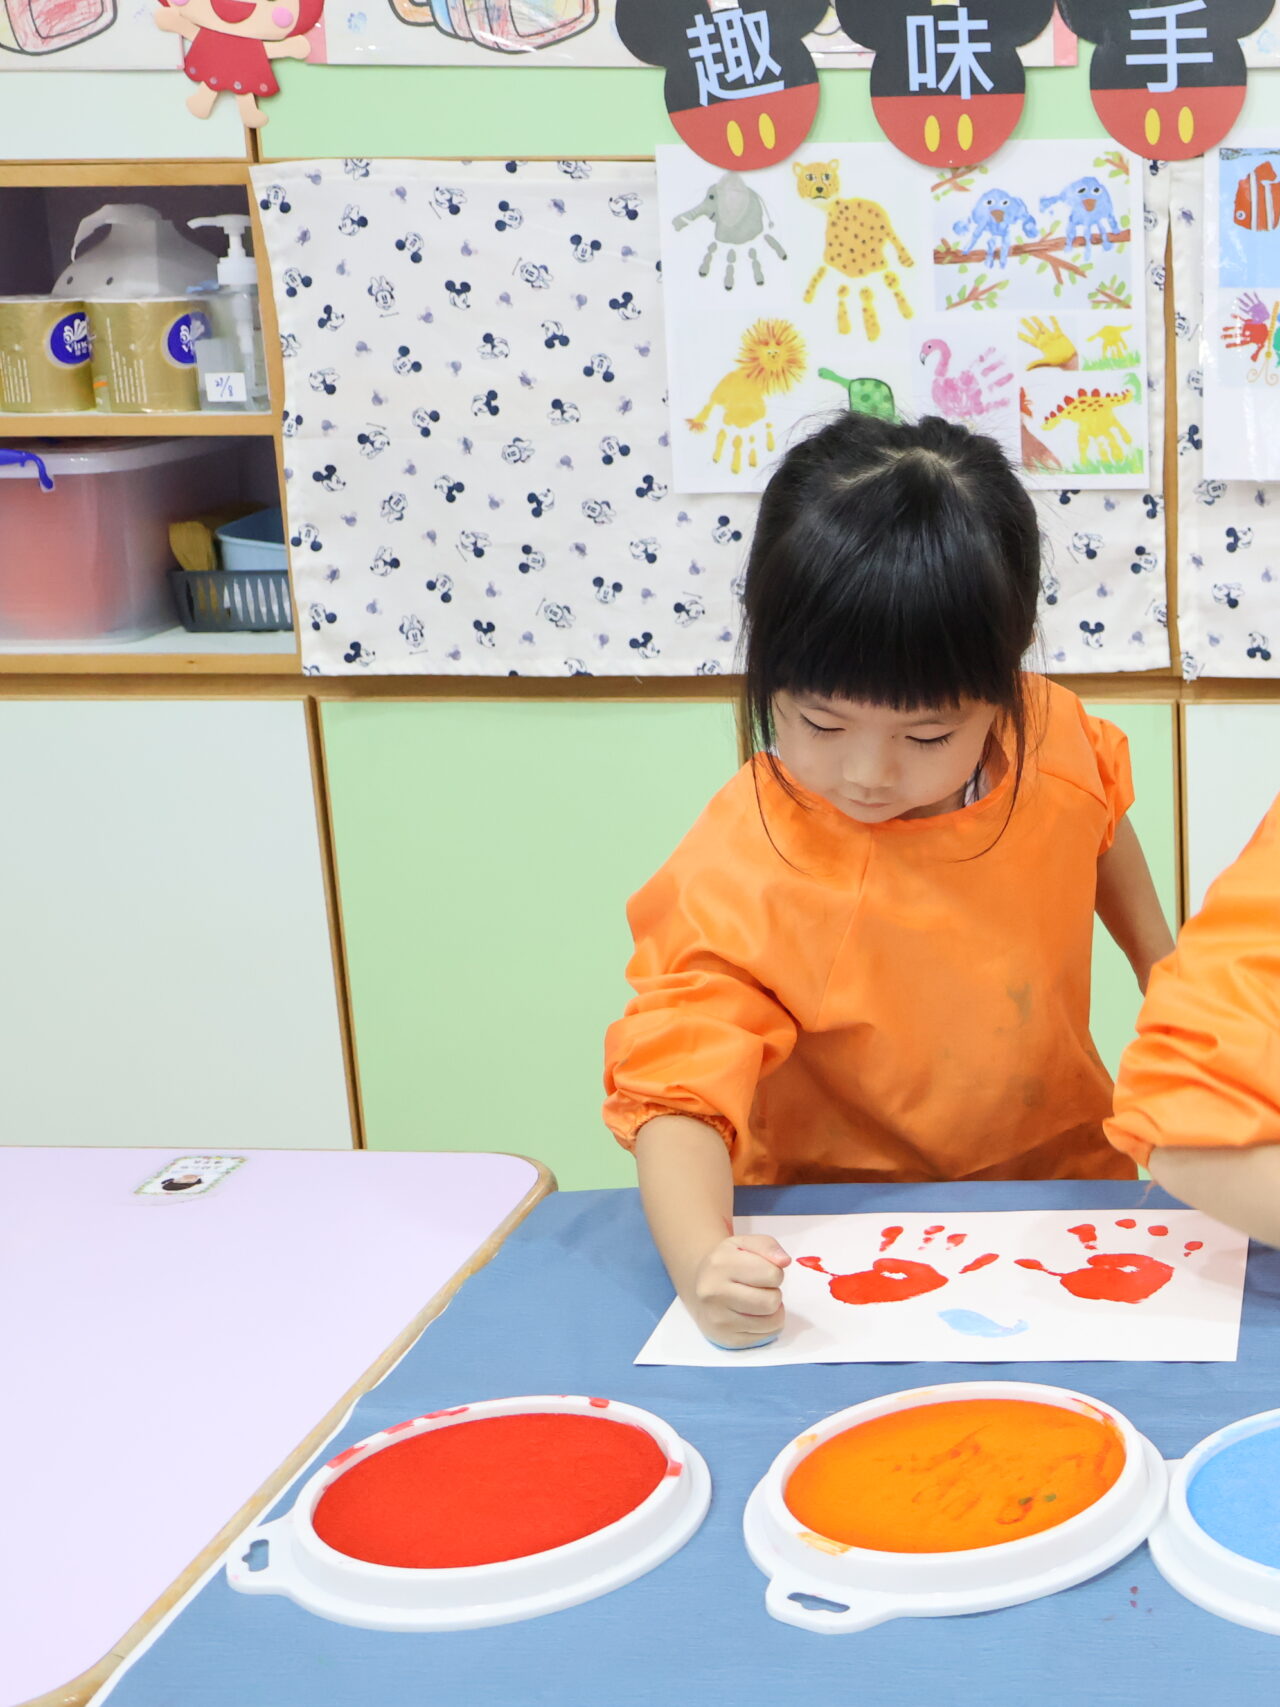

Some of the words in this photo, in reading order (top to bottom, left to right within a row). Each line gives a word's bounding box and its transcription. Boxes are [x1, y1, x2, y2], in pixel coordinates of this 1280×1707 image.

[686, 8, 785, 107] 趣
[906, 7, 995, 100] 味
[1126, 0, 1214, 93] 手
